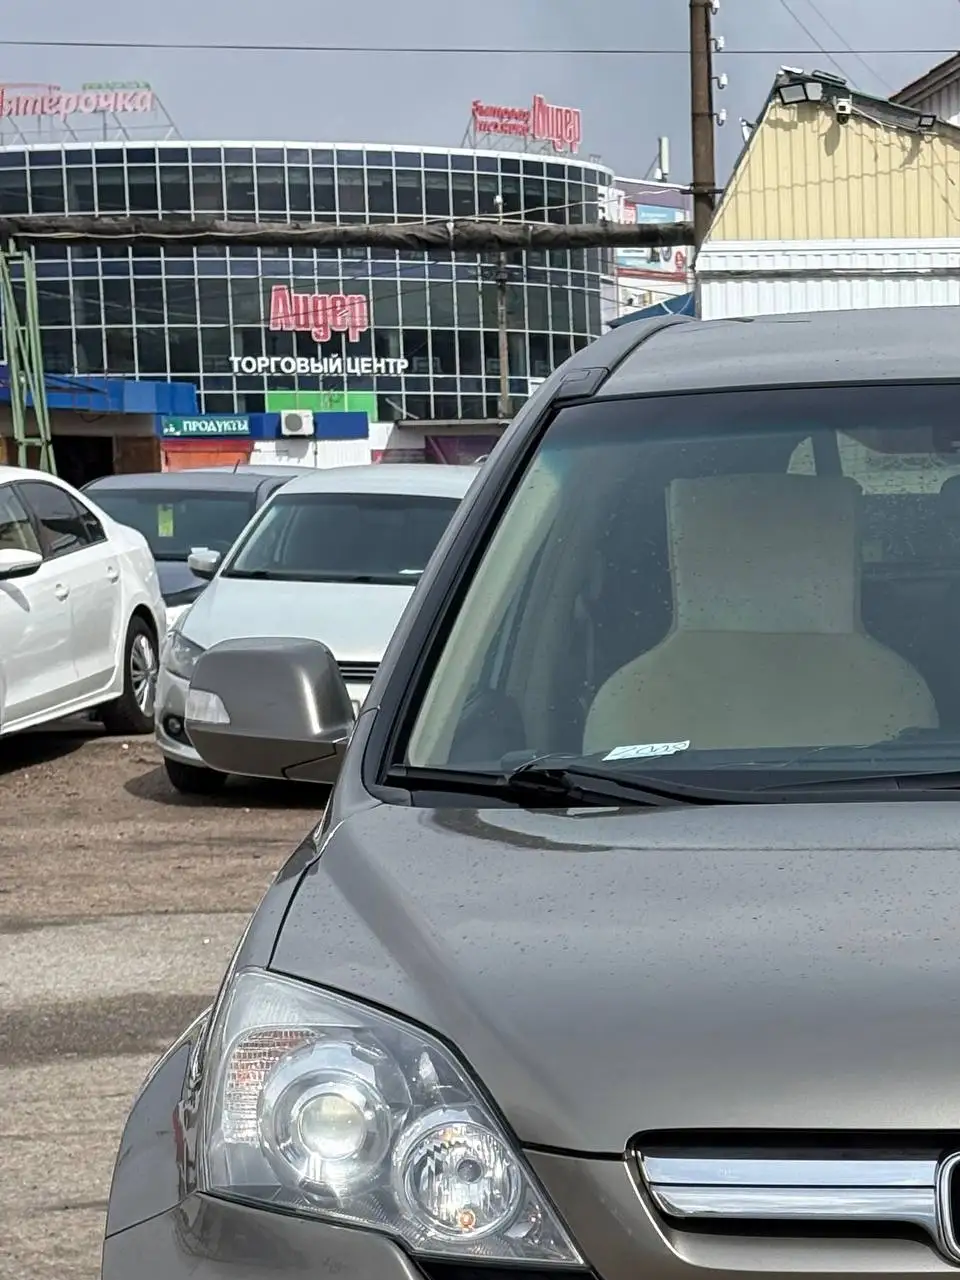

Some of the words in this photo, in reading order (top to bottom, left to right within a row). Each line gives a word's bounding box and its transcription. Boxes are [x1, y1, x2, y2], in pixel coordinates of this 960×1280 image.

[0, 83, 156, 121] ятёрочка
[269, 285, 368, 342] Лидер
[229, 353, 342, 374] ТОРГОВЫЙ
[346, 357, 408, 376] ЦЕНТР
[182, 419, 249, 433] ПРОДУКТЫ
